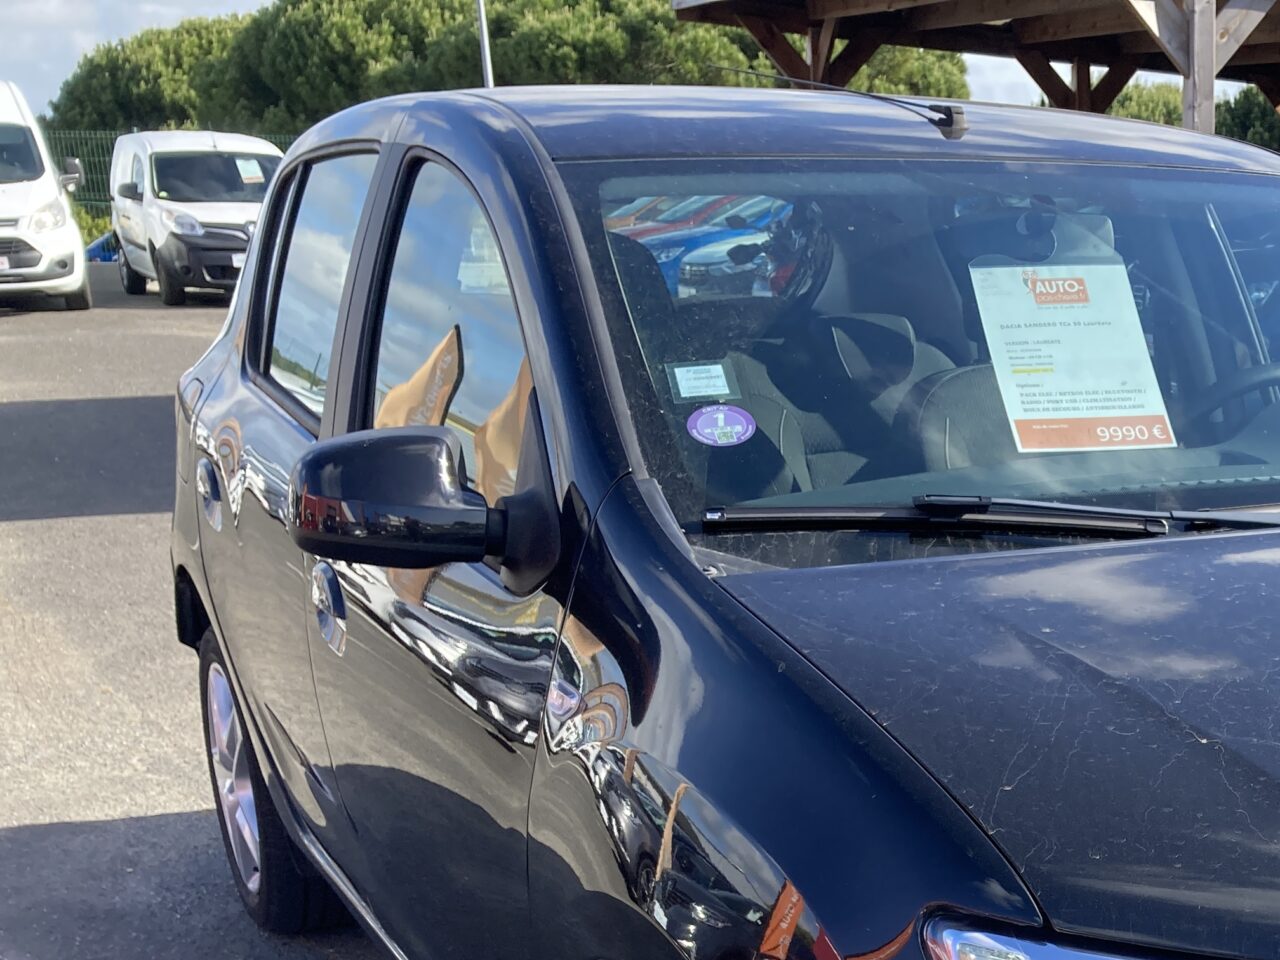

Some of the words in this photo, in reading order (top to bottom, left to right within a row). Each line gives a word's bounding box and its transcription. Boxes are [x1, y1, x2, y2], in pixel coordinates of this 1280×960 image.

[1035, 280, 1084, 294] AUTO-
[1096, 425, 1149, 442] 9990
[1152, 424, 1168, 439] €
